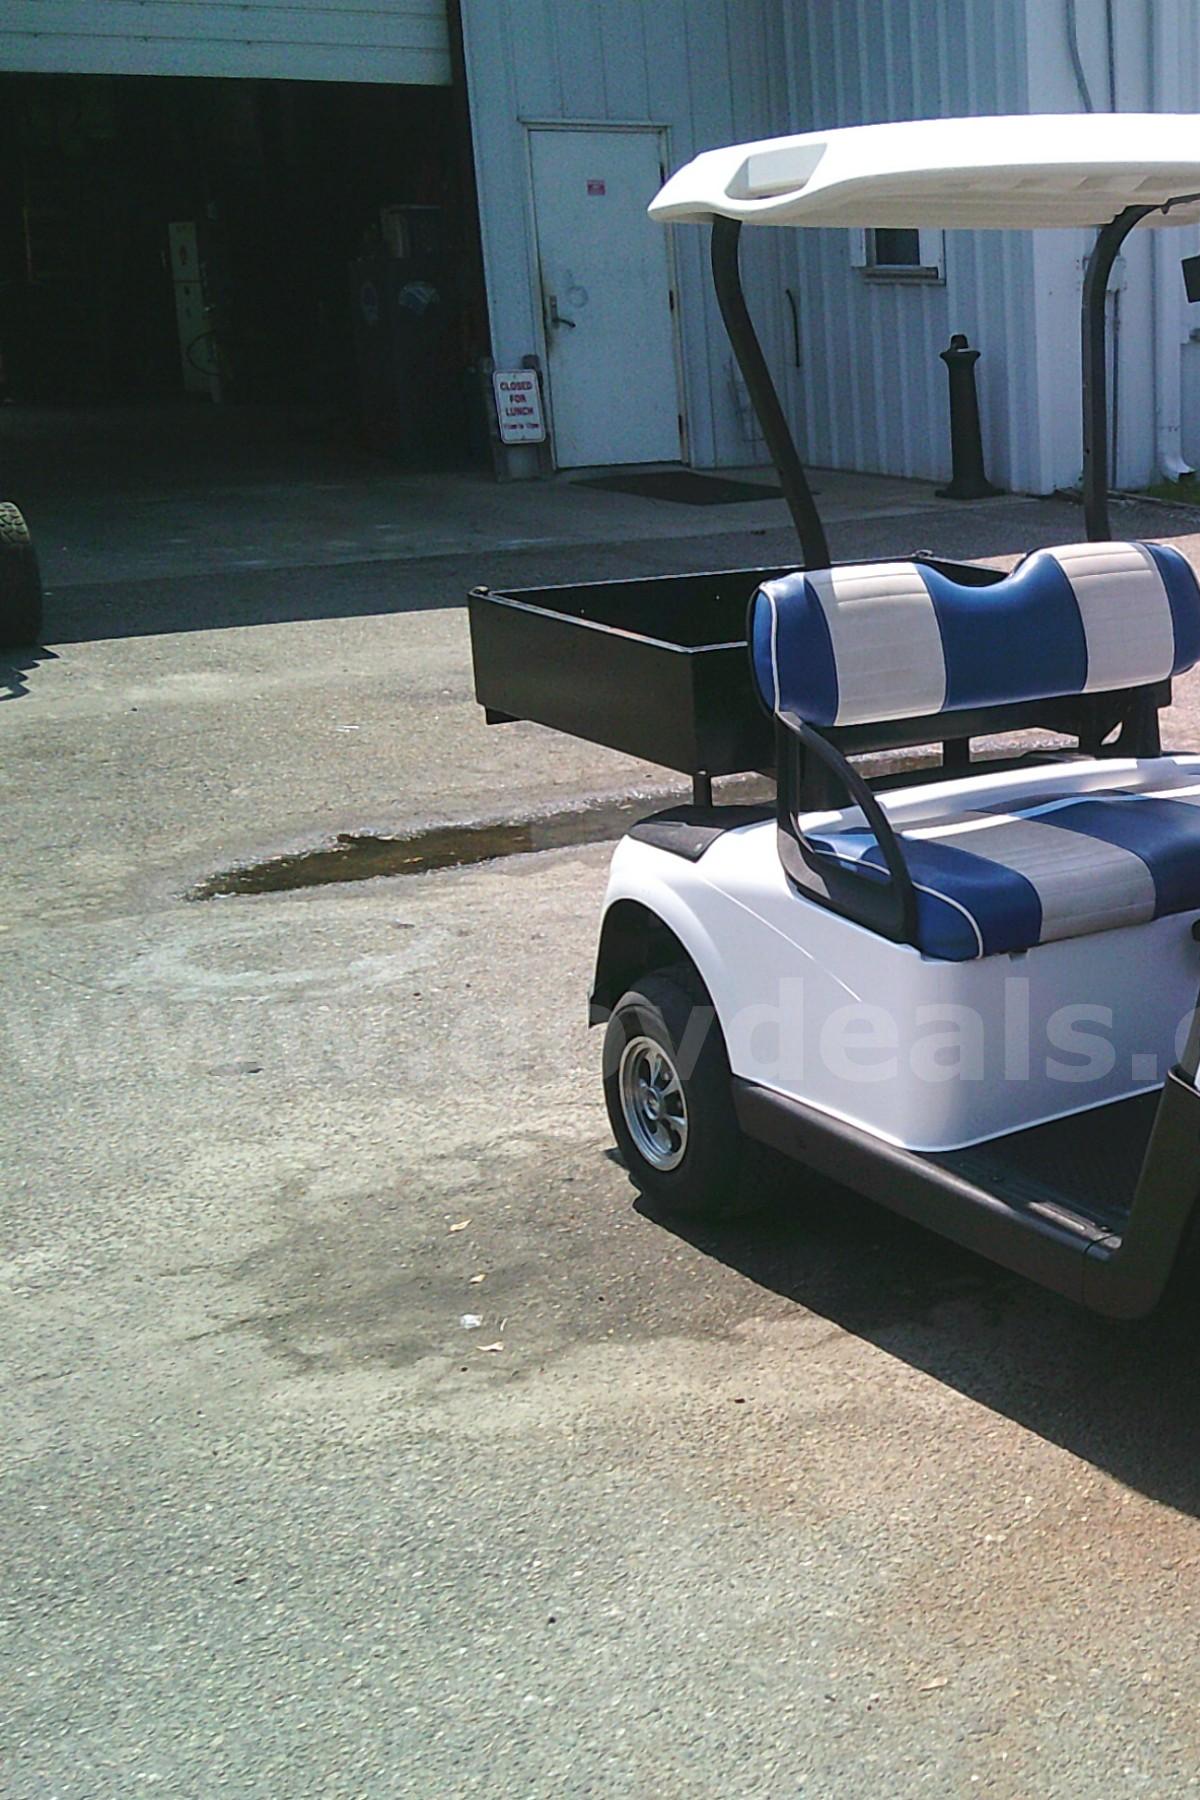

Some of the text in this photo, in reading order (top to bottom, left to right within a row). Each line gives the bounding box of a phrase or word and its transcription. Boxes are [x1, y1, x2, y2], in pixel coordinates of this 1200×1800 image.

[500, 381, 532, 390] CLOSED
[510, 394, 527, 403] FOR
[506, 407, 533, 416] LUNCH
